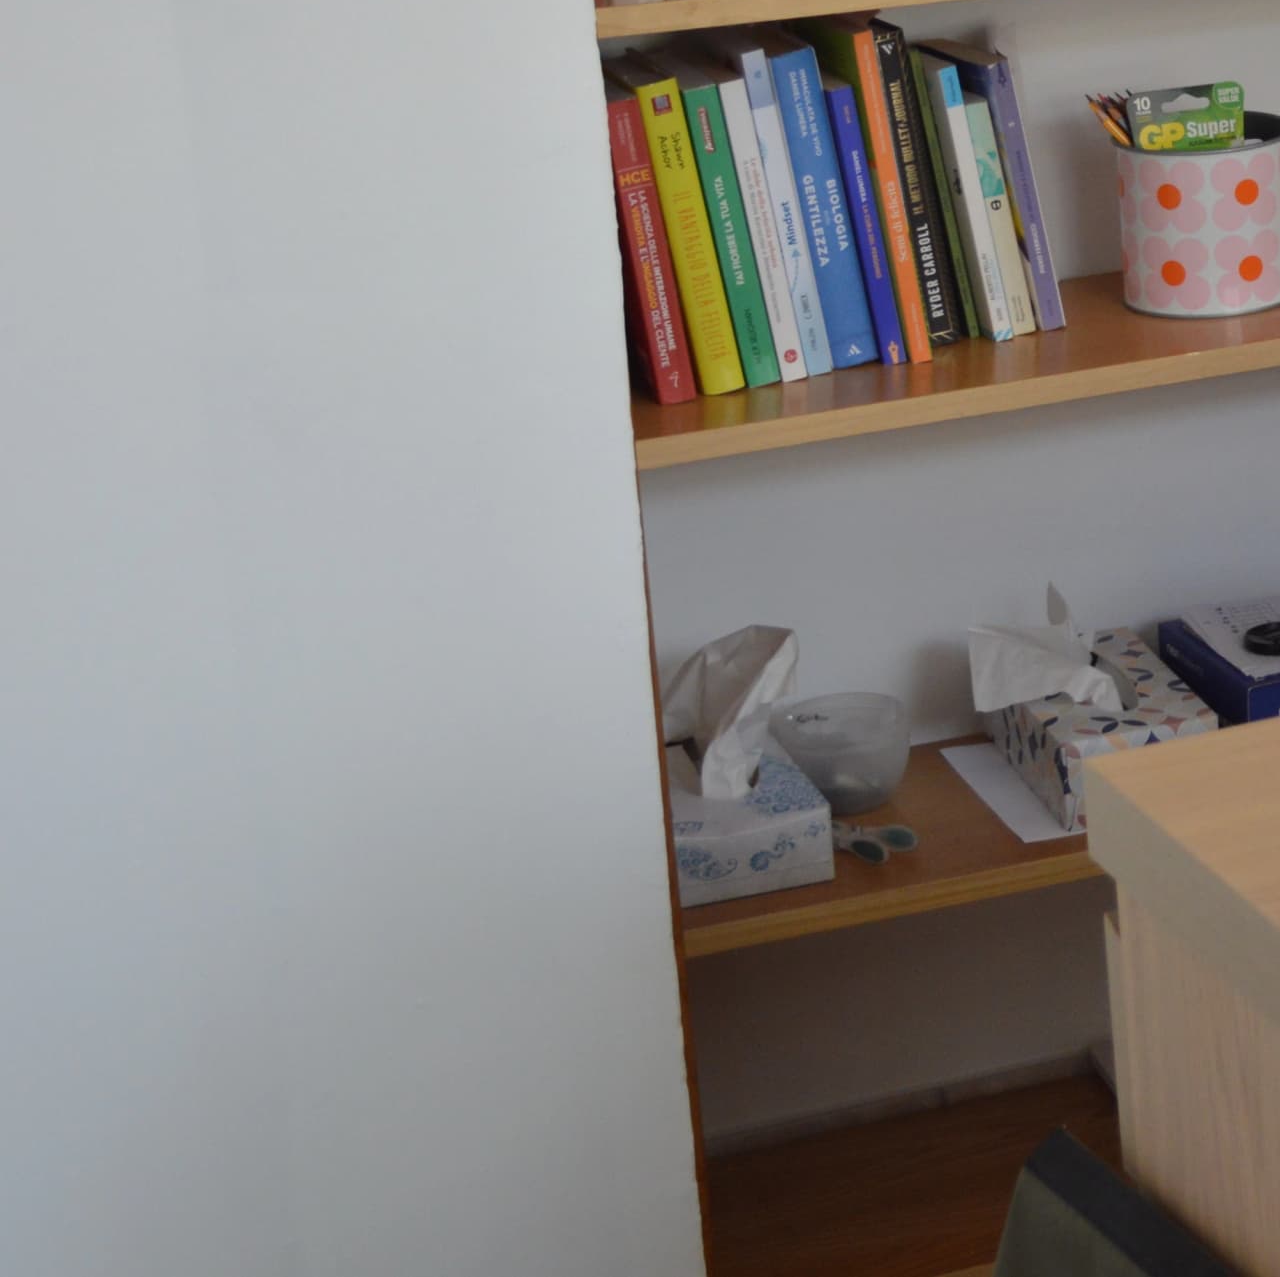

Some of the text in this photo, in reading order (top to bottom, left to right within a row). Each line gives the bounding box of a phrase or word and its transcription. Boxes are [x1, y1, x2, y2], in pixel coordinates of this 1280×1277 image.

[1133, 96, 1152, 111] 10
[656, 134, 675, 170] Achor
[669, 131, 687, 170] Shawn
[1139, 118, 1237, 151] GP Super
[618, 168, 650, 186] HCE
[637, 189, 646, 201] LA
[627, 192, 637, 206] LA
[824, 178, 850, 251] BIOLOGIA
[639, 202, 653, 239] SCIENZA
[712, 174, 746, 285] FAI FIORIRE LA TUA VITA
[779, 200, 798, 246] Mindset
[800, 174, 831, 267] GENTILEZZA
[637, 247, 647, 255] E
[646, 239, 659, 265] DELLE
[671, 190, 691, 203] IL
[691, 272, 716, 308] DELLA
[915, 222, 945, 318] RYDER CARROLL
[650, 309, 661, 328] DEL
[662, 319, 675, 350] UMANE
[653, 329, 669, 368] CLIENTE
